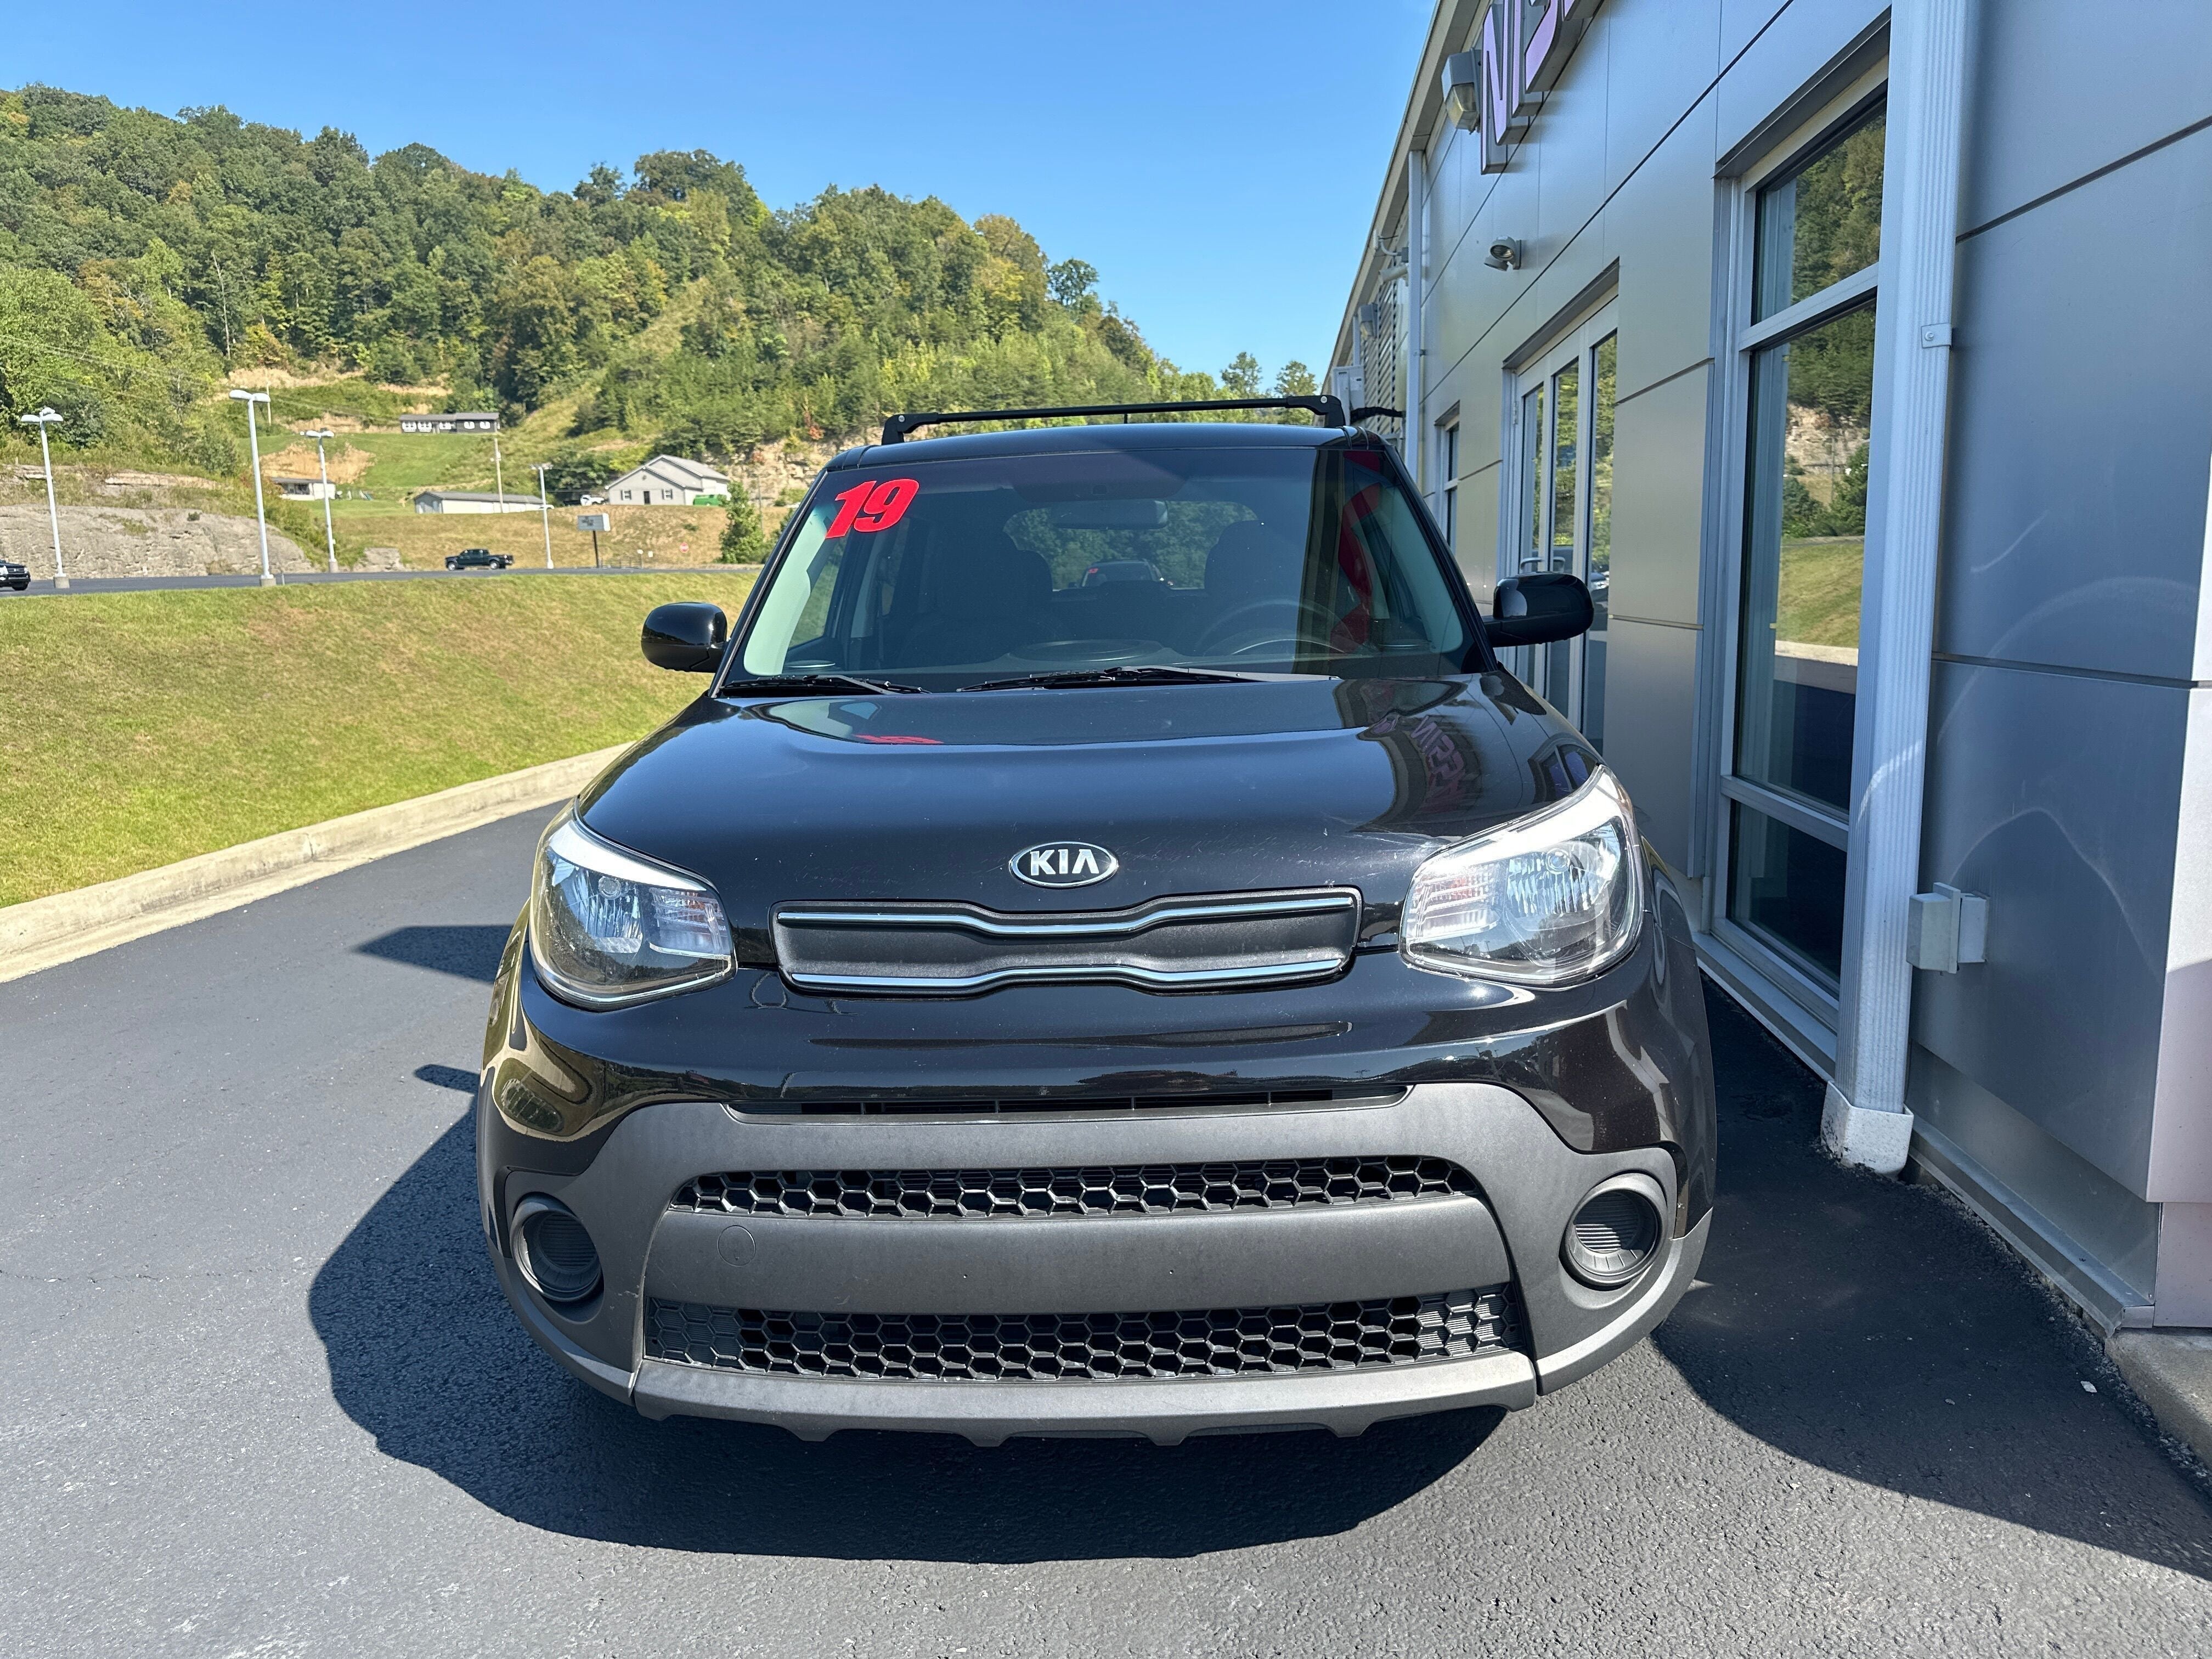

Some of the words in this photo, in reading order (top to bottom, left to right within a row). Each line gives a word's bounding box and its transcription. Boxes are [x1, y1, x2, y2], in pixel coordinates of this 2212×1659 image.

[1481, 0, 1576, 174] NIS
[825, 478, 919, 539] 19
[1030, 849, 1099, 876] KIA
